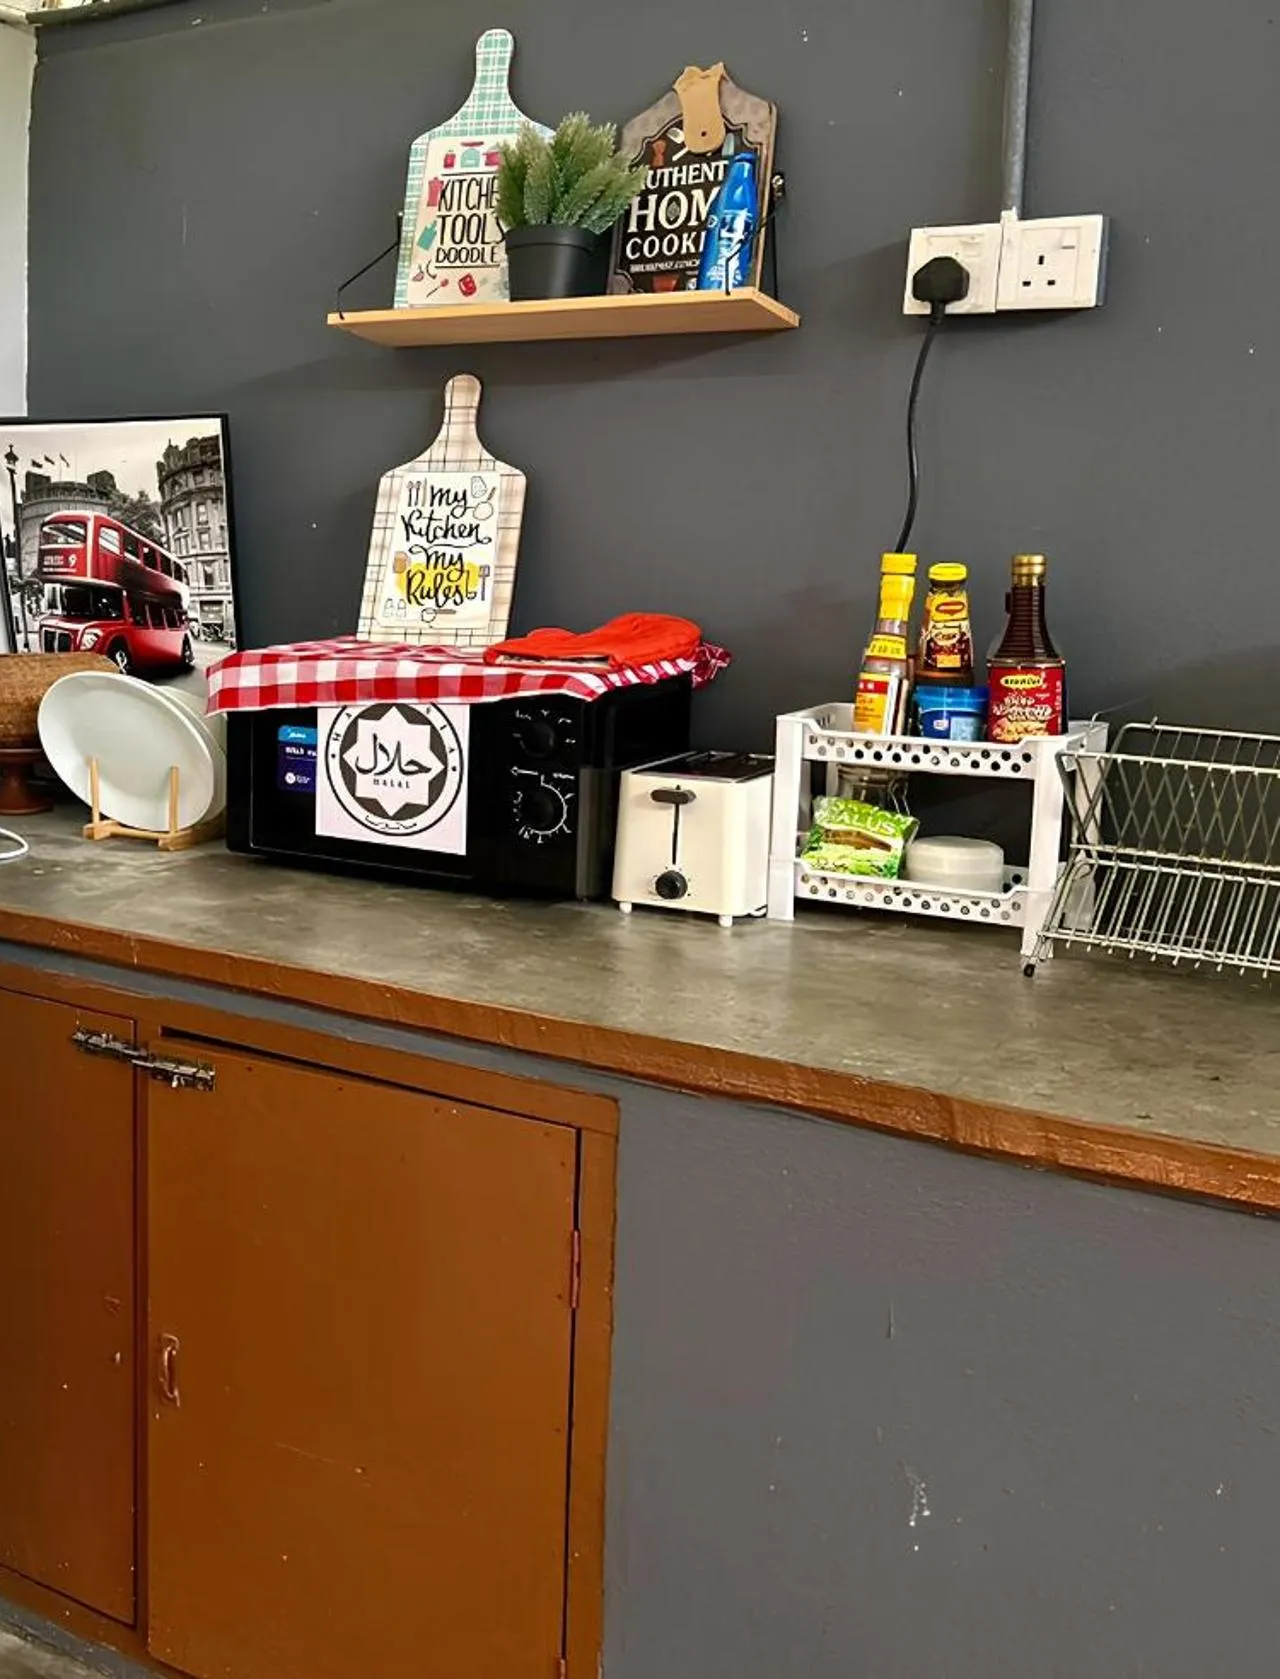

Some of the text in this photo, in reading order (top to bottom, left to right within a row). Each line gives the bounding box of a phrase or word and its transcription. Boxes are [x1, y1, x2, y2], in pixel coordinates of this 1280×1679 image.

[641, 160, 729, 189] UTHENT
[438, 176, 500, 212] KITCHE
[627, 186, 721, 233] HOM
[436, 212, 506, 245] TOOLS
[626, 231, 707, 260] COOKI
[429, 484, 468, 519] my
[401, 508, 492, 544] Kitchen
[408, 544, 465, 583] my
[355, 733, 432, 776] حلال
